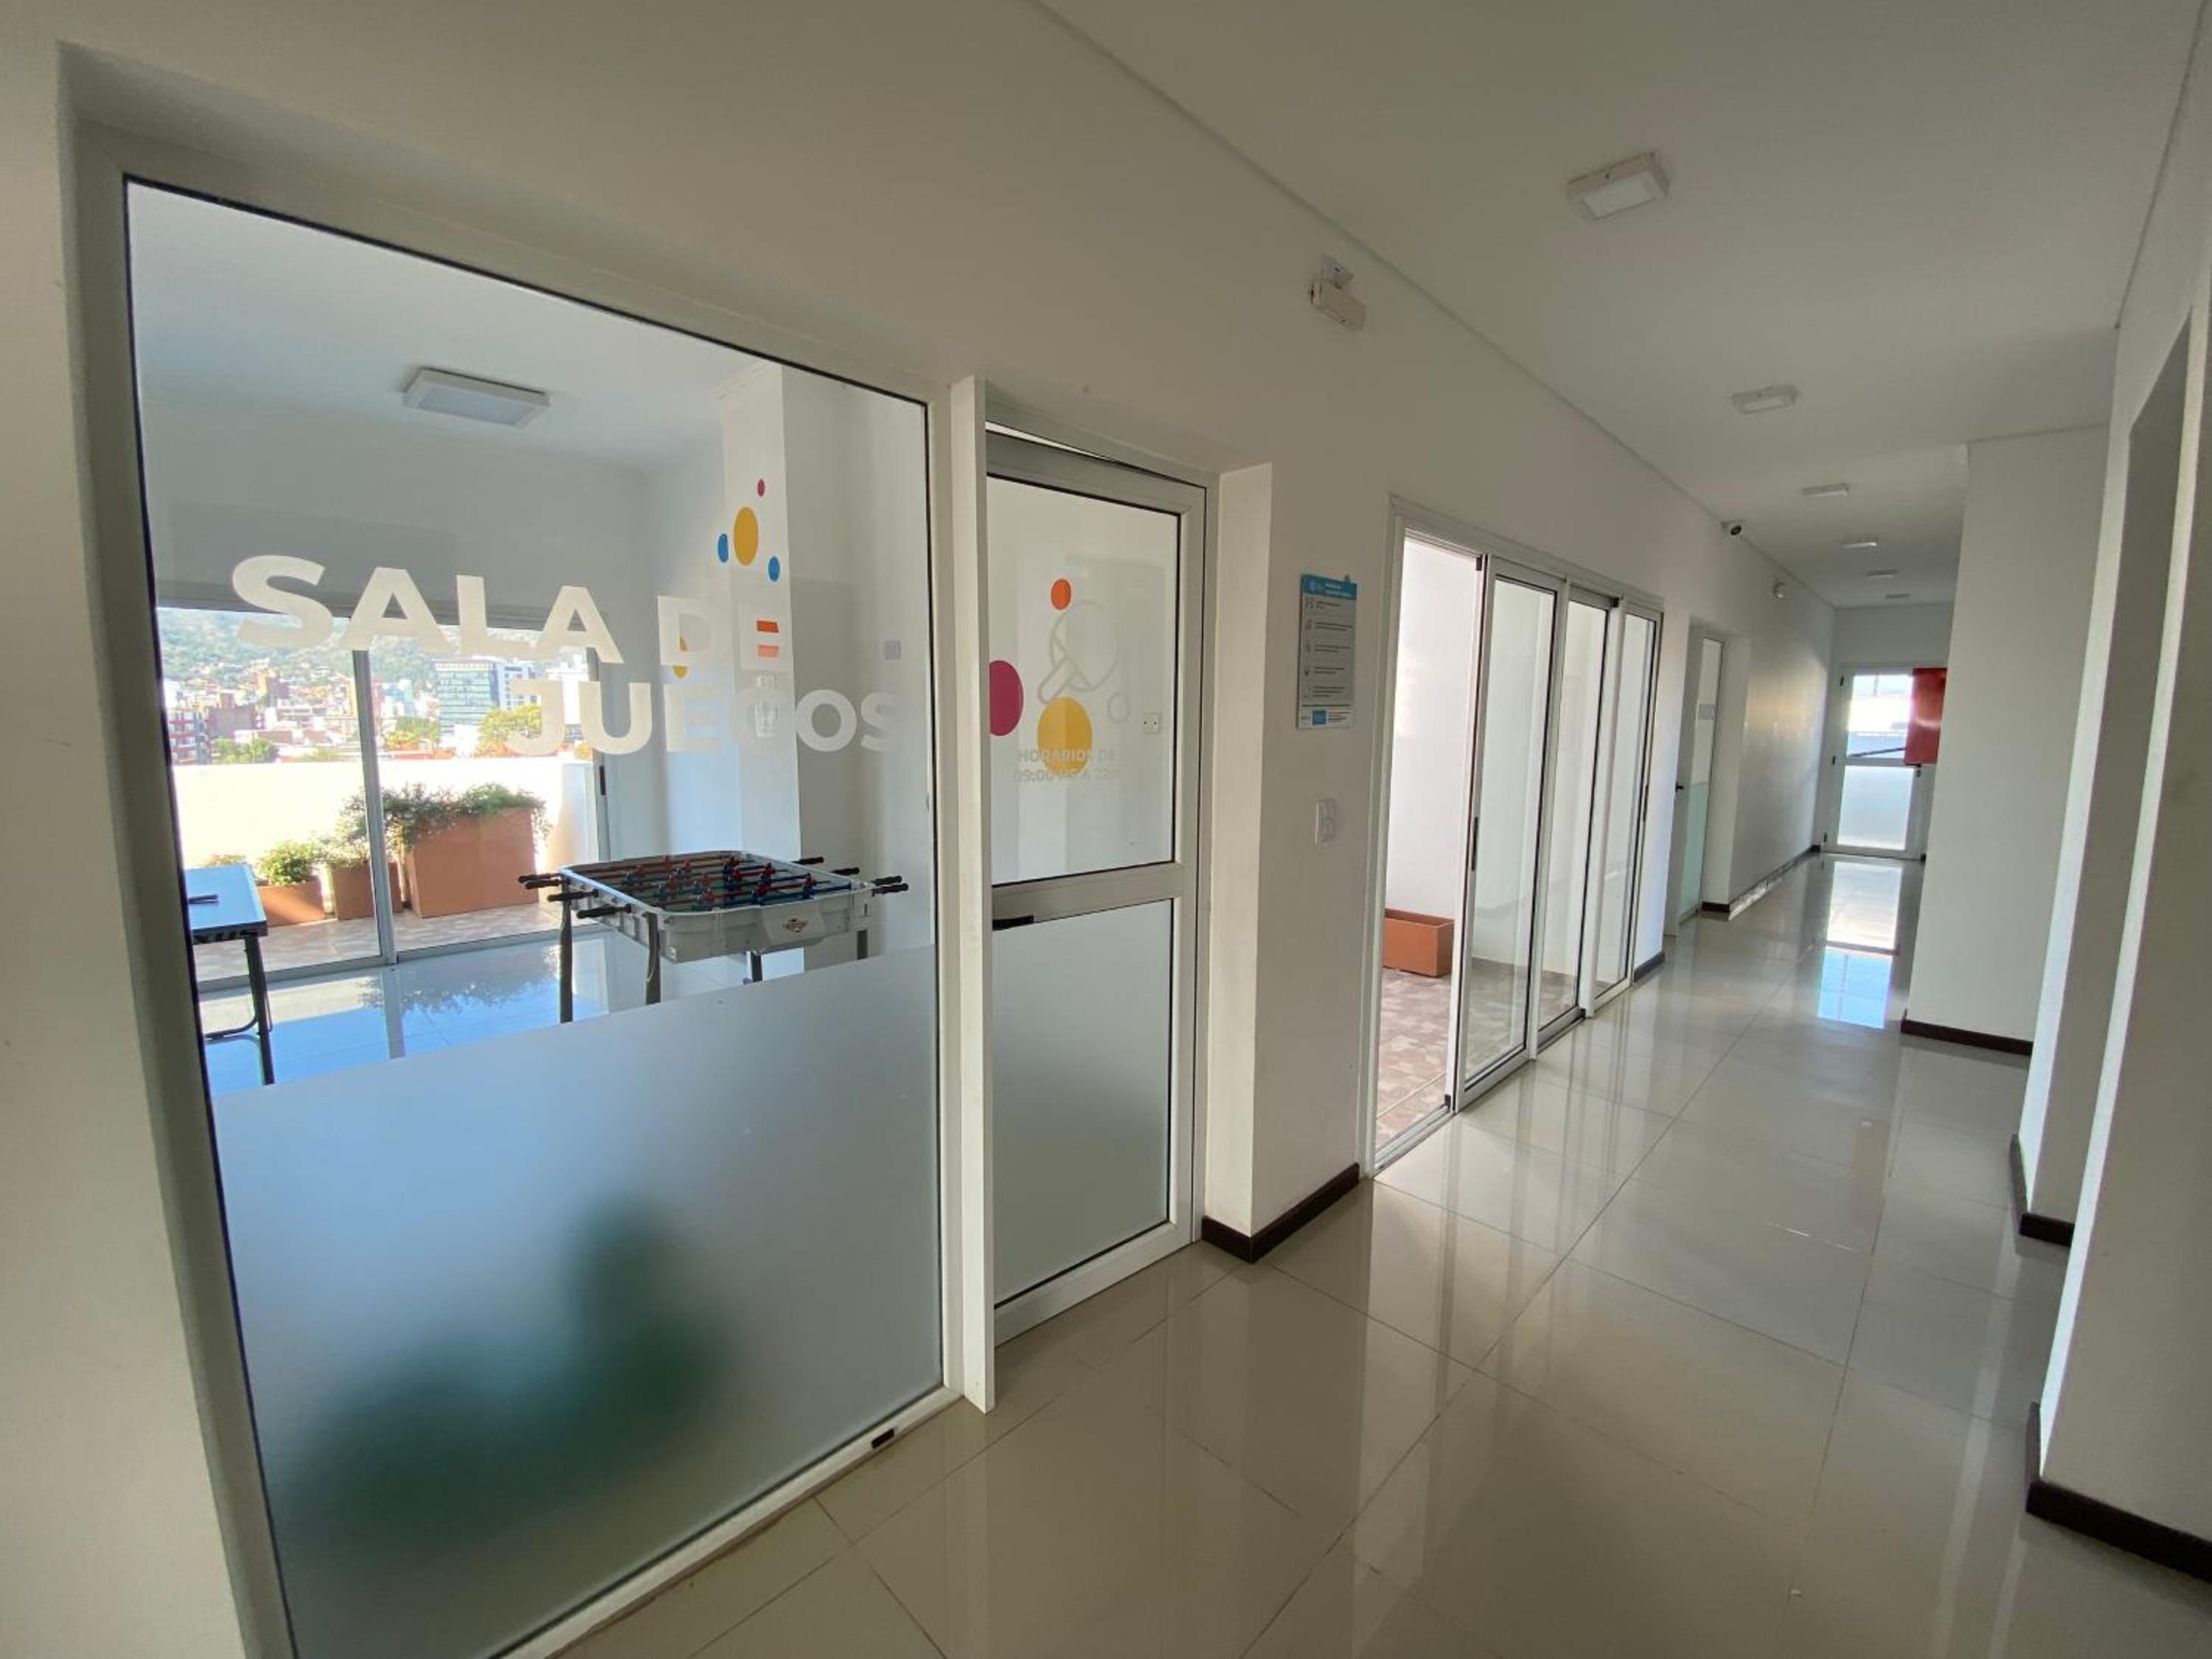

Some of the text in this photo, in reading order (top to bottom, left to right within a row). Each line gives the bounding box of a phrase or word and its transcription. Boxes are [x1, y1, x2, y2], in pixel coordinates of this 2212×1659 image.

[232, 555, 792, 672] SALA DE
[507, 677, 901, 755] JUEGOS
